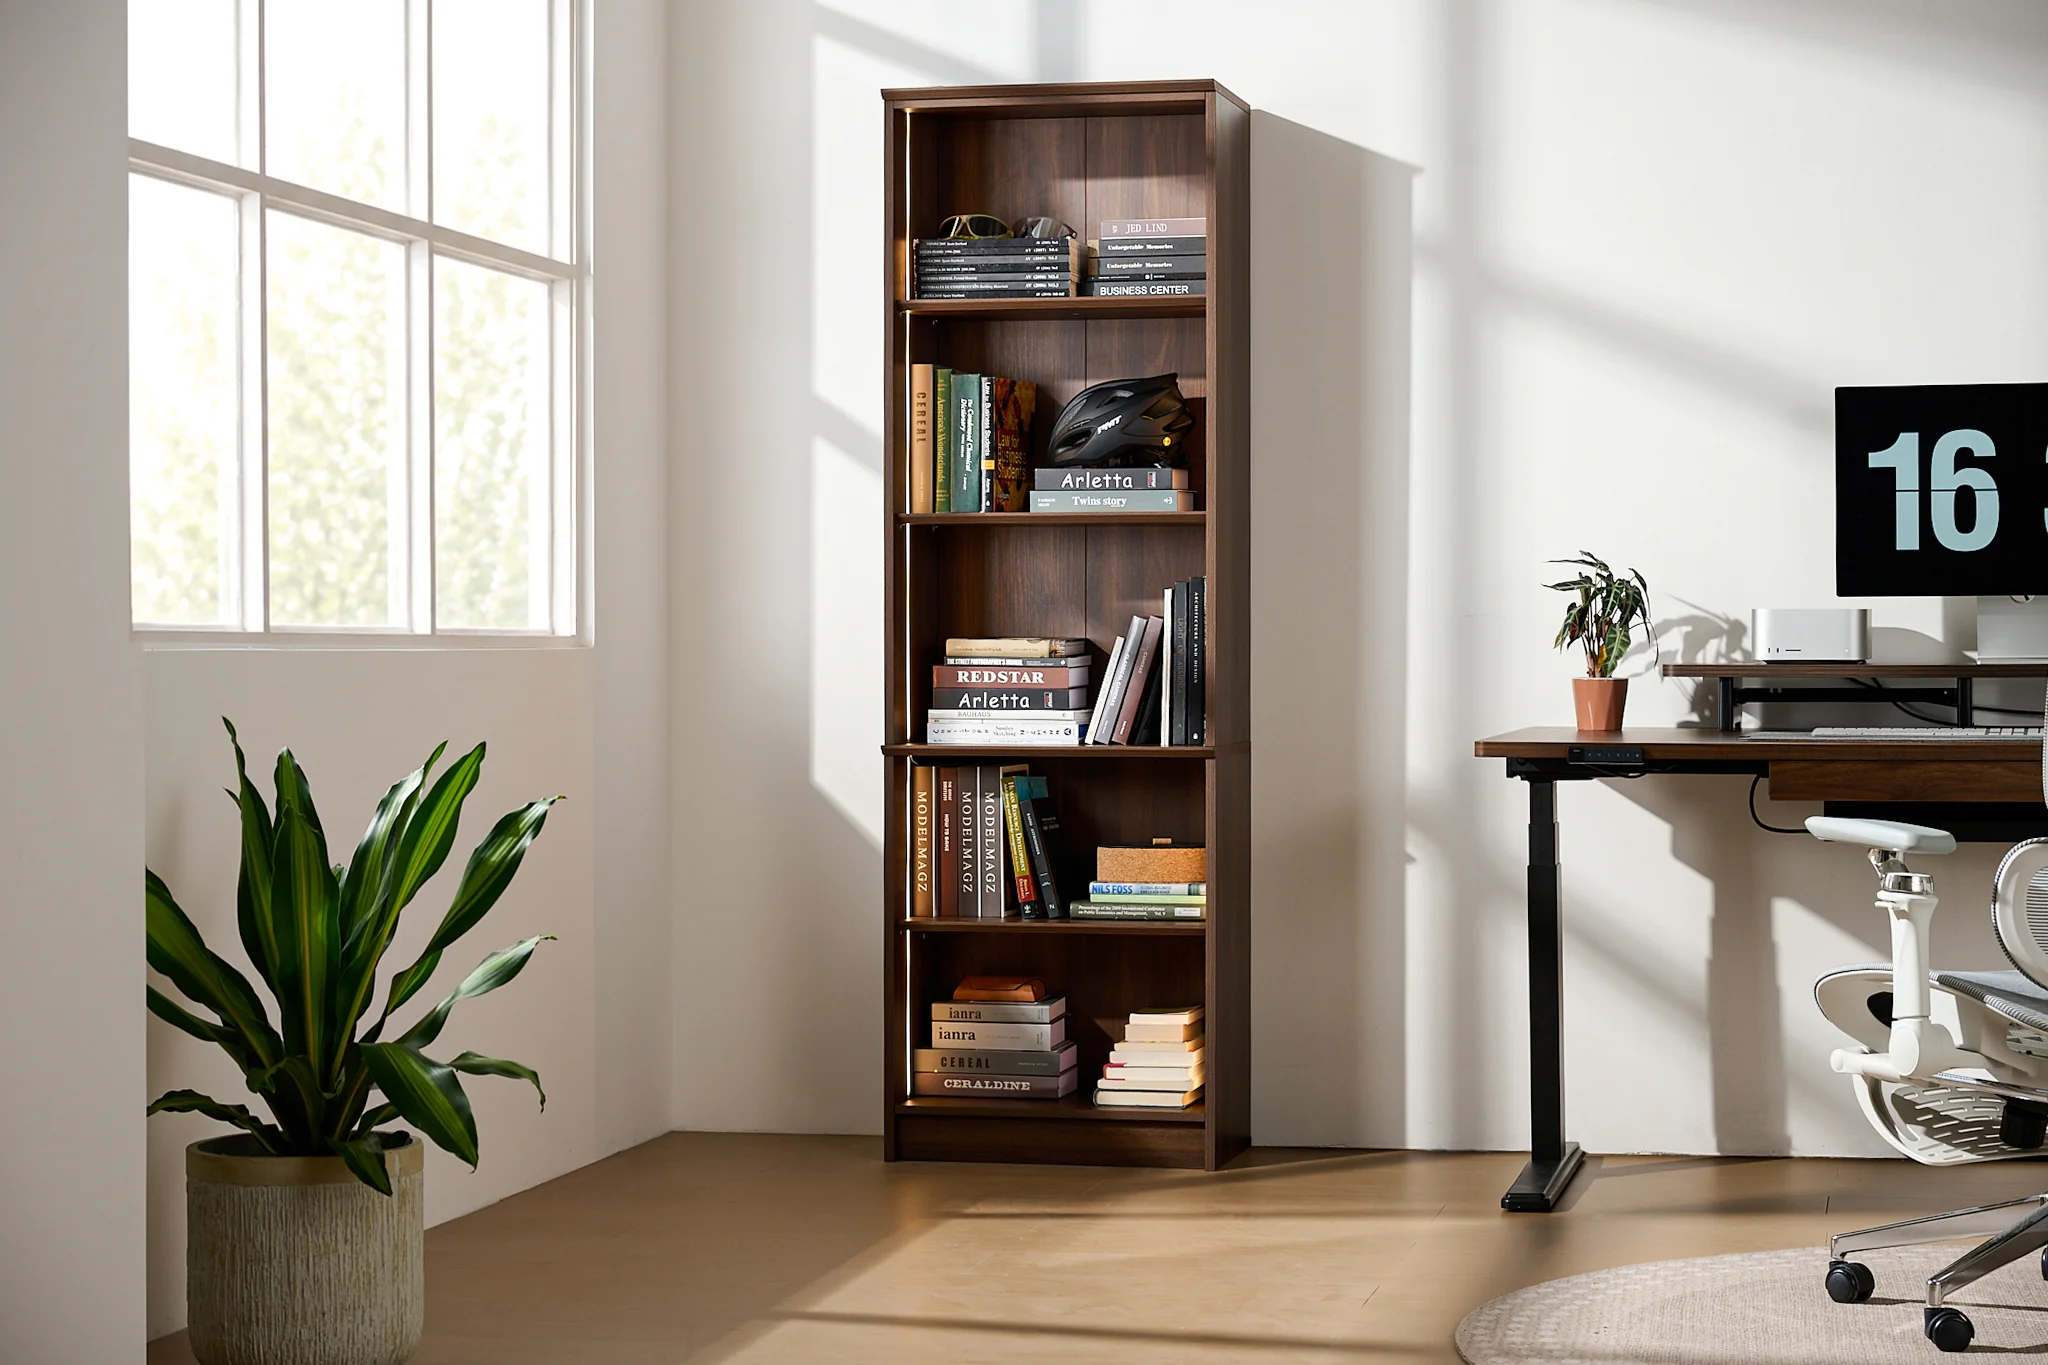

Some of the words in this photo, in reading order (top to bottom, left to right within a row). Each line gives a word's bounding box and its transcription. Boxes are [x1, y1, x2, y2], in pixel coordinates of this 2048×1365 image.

[1125, 224, 1141, 234] JED
[1146, 223, 1168, 232] LIND
[1100, 286, 1147, 296] BUSINESS
[1149, 285, 1189, 294] CENTER
[916, 392, 927, 443] CEREAL
[959, 398, 967, 432] Dictionary
[937, 433, 947, 483] Wonderlands
[1060, 471, 1133, 489] Arletta
[1868, 428, 2000, 552] 16
[1072, 496, 1101, 506] Twins
[1102, 497, 1127, 507] story
[956, 670, 1045, 683] REDSTAR
[958, 691, 1030, 708] Arletta
[1008, 781, 1016, 803] HUMAN
[1011, 803, 1020, 831] RESOURCE
[917, 791, 928, 892] MODELMAGZ
[962, 791, 973, 893] MODELMAGZ
[985, 792, 996, 893] MODELMAGZ
[1016, 833, 1026, 872] DEVELOPMENT
[1091, 884, 1111, 894] NILS
[1111, 884, 1133, 894] FOSS
[949, 1007, 982, 1020] ianra
[938, 1026, 976, 1041] ianra
[940, 1056, 990, 1069] CEREAL
